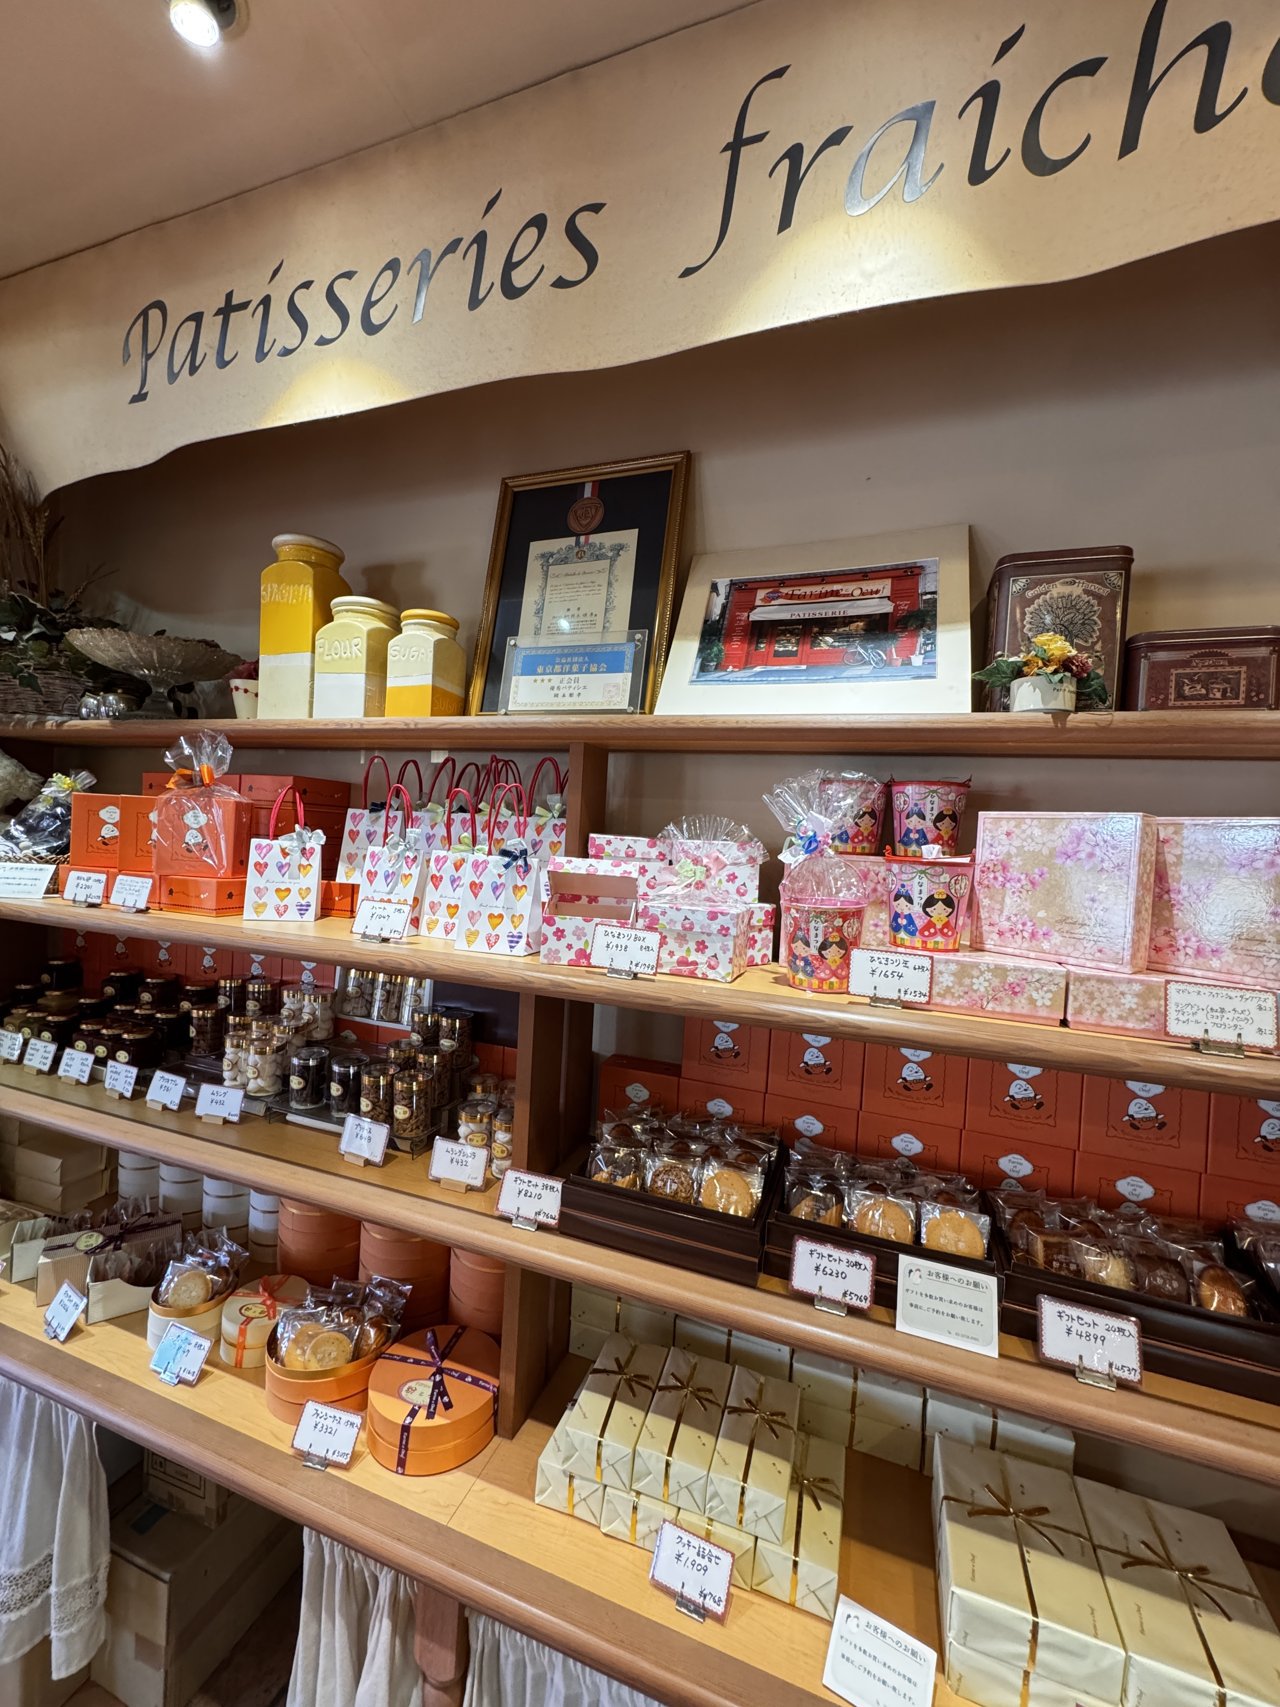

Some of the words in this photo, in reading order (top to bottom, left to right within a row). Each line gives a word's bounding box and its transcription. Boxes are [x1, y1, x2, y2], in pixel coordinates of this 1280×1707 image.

[122, 187, 608, 405] Patisseries
[1025, 581, 1059, 599] Golden
[1076, 579, 1111, 597] Harvest
[789, 609, 849, 619] PATISSERIE
[316, 636, 363, 664] FLOUR
[869, 966, 905, 981] ¥1654
[516, 1187, 543, 1200] ¥8210
[813, 1263, 848, 1280] ¥6230
[927, 1269, 989, 1291] お客様へのお願い
[842, 1289, 869, 1304] ¥5769
[1056, 1309, 1100, 1330] ギフトセット
[1064, 1324, 1106, 1347] ¥4899
[1108, 1361, 1138, 1377] 4537
[313, 1420, 338, 1437] ¥3321
[698, 1585, 724, 1607] ¥768
[864, 1620, 927, 1663] お客様へのお願い
